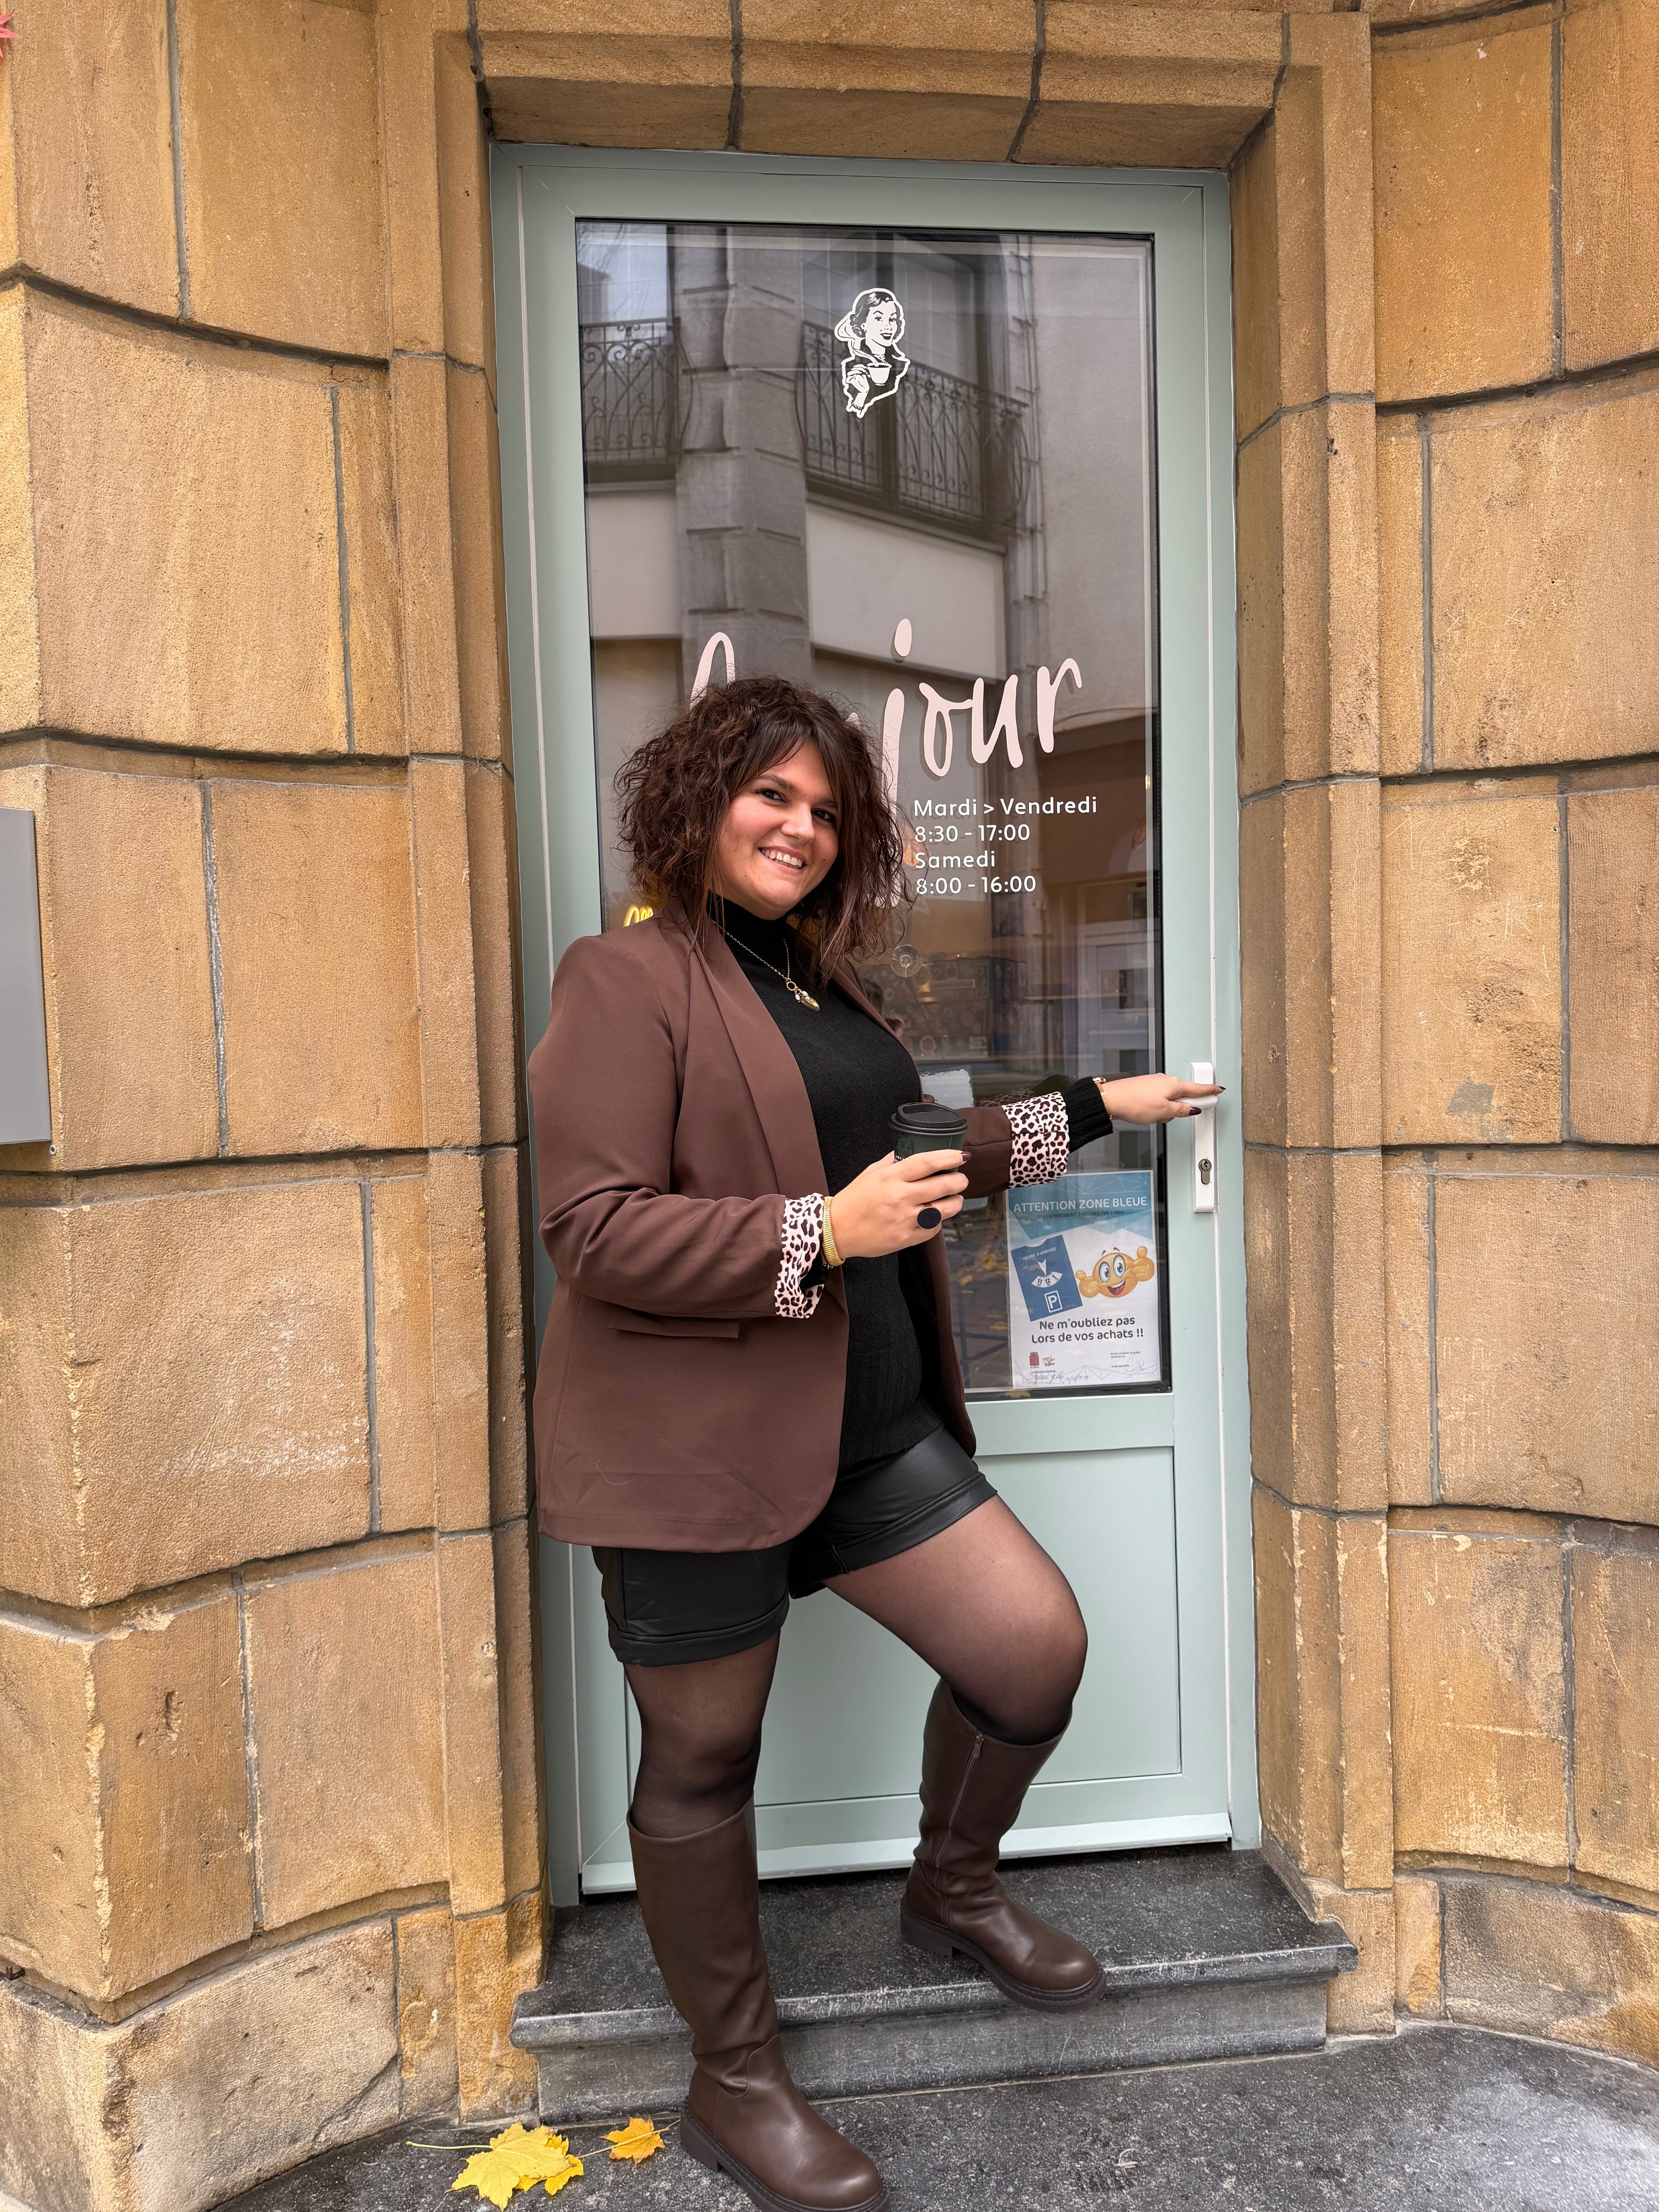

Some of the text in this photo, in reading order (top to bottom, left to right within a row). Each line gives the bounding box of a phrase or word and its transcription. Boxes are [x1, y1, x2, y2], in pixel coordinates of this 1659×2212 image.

[914, 798, 976, 816] Mardi
[1000, 796, 1096, 814] Vendredi
[915, 825, 958, 842] 8:30
[978, 824, 1030, 841] 17:00
[915, 850, 995, 868] Samedi
[916, 877, 961, 894] 8:00
[982, 875, 1036, 893] 16:00
[1013, 1196, 1147, 1213] ATTENTION ZONE BLEUE
[1047, 1296, 1058, 1309] P
[1039, 1317, 1135, 1330] Ne m'oubliez pas
[1031, 1328, 1144, 1344] Lors de vos achats !!
